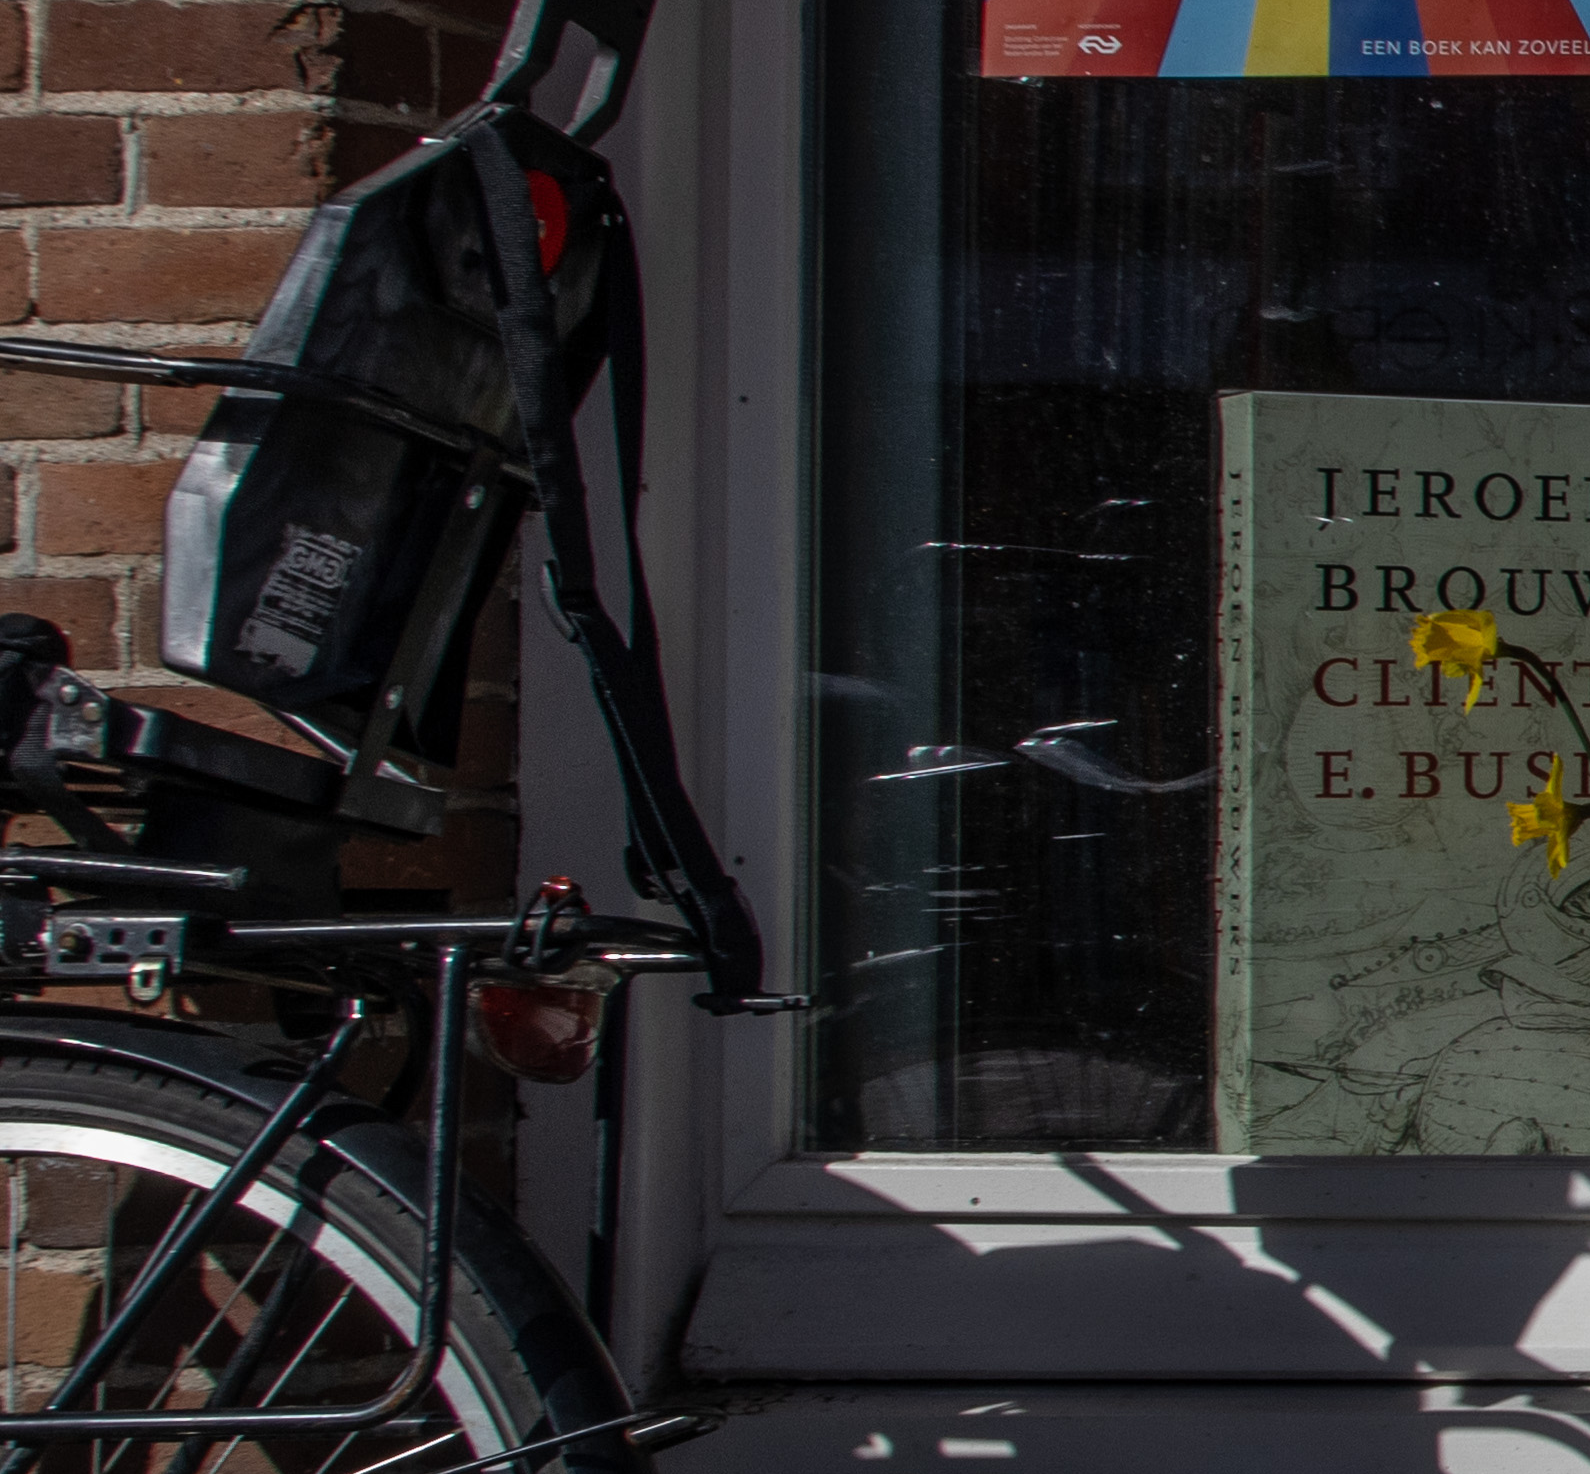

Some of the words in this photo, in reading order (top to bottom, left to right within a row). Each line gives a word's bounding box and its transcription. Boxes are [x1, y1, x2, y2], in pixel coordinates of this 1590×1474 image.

[1361, 38, 1401, 56] EEN
[1408, 38, 1463, 56] BOEK
[1469, 38, 1512, 56] KAN
[1314, 751, 1375, 799] E.
